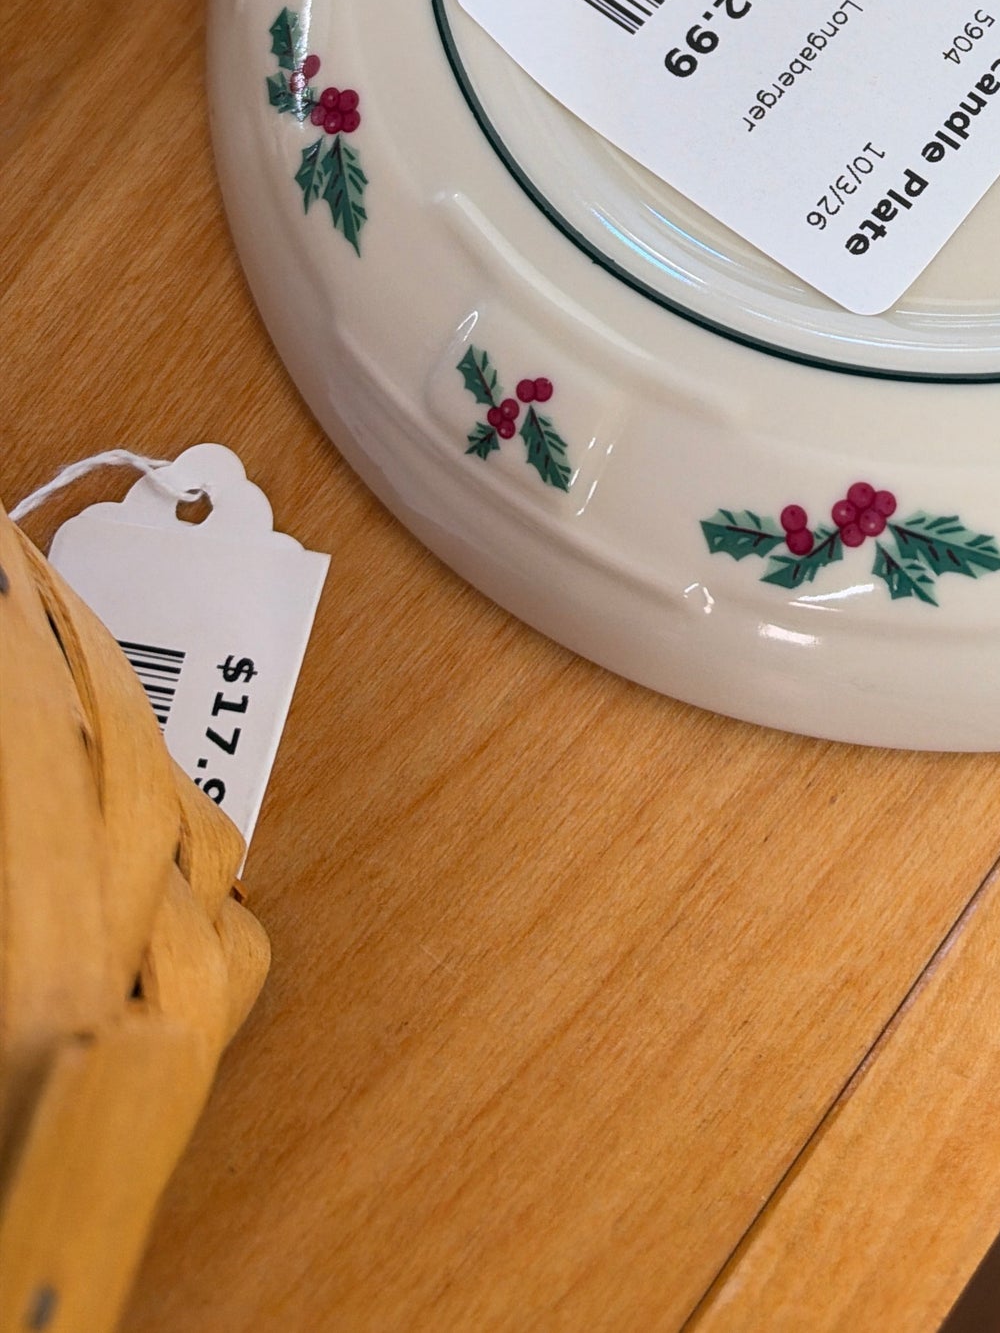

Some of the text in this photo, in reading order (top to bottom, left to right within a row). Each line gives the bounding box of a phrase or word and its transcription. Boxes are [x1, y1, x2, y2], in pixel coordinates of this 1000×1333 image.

[742, 0, 863, 132] Longaberger
[806, 9, 995, 231] 5904 10/3/26
[844, 168, 929, 255] Plate
